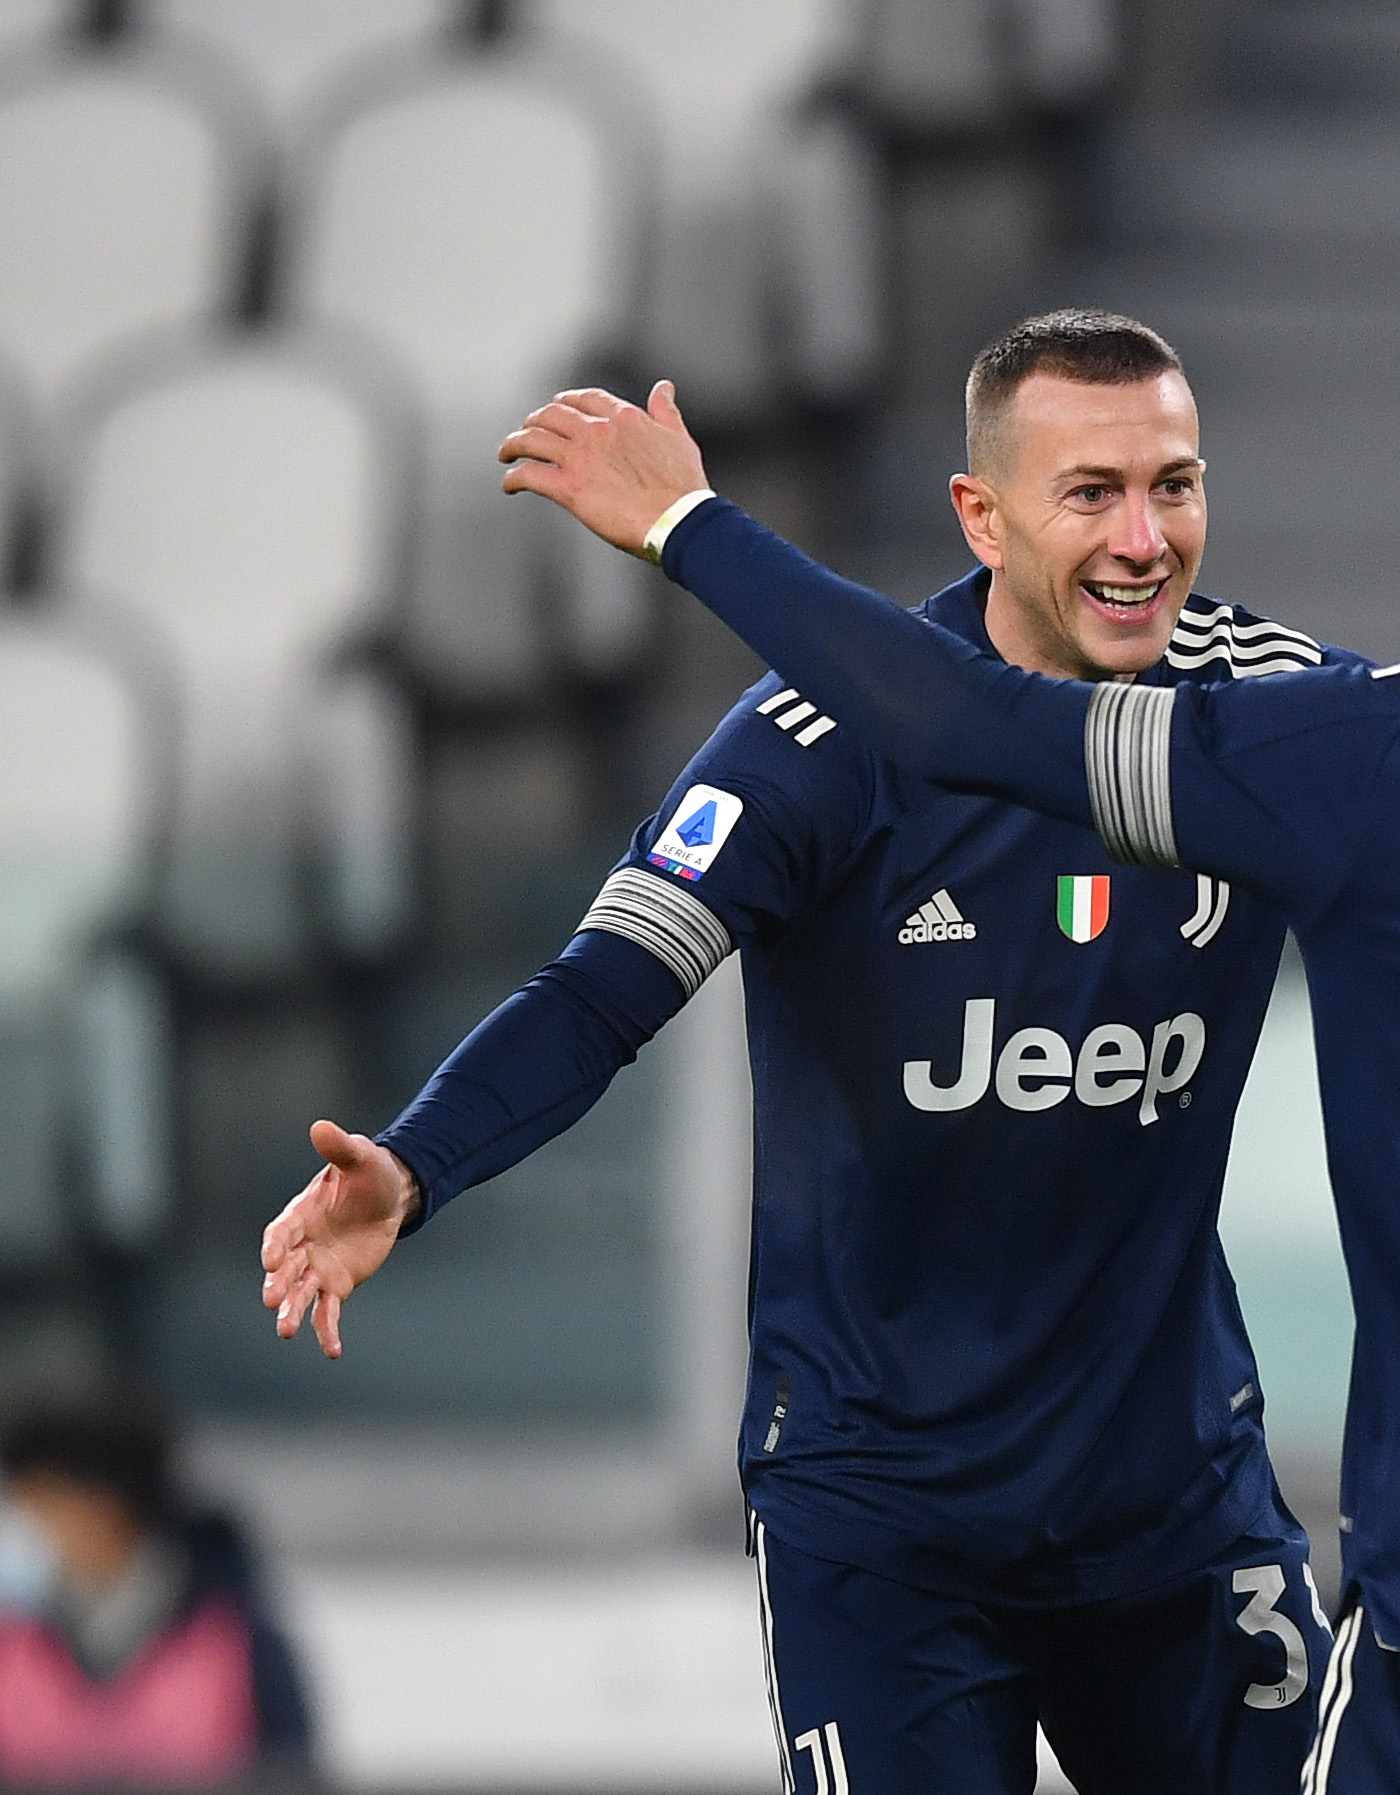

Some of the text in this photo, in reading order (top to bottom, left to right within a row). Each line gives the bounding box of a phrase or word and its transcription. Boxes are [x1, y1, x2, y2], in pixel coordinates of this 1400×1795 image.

[661, 844, 703, 866] SERIE A
[898, 921, 977, 945] adidas
